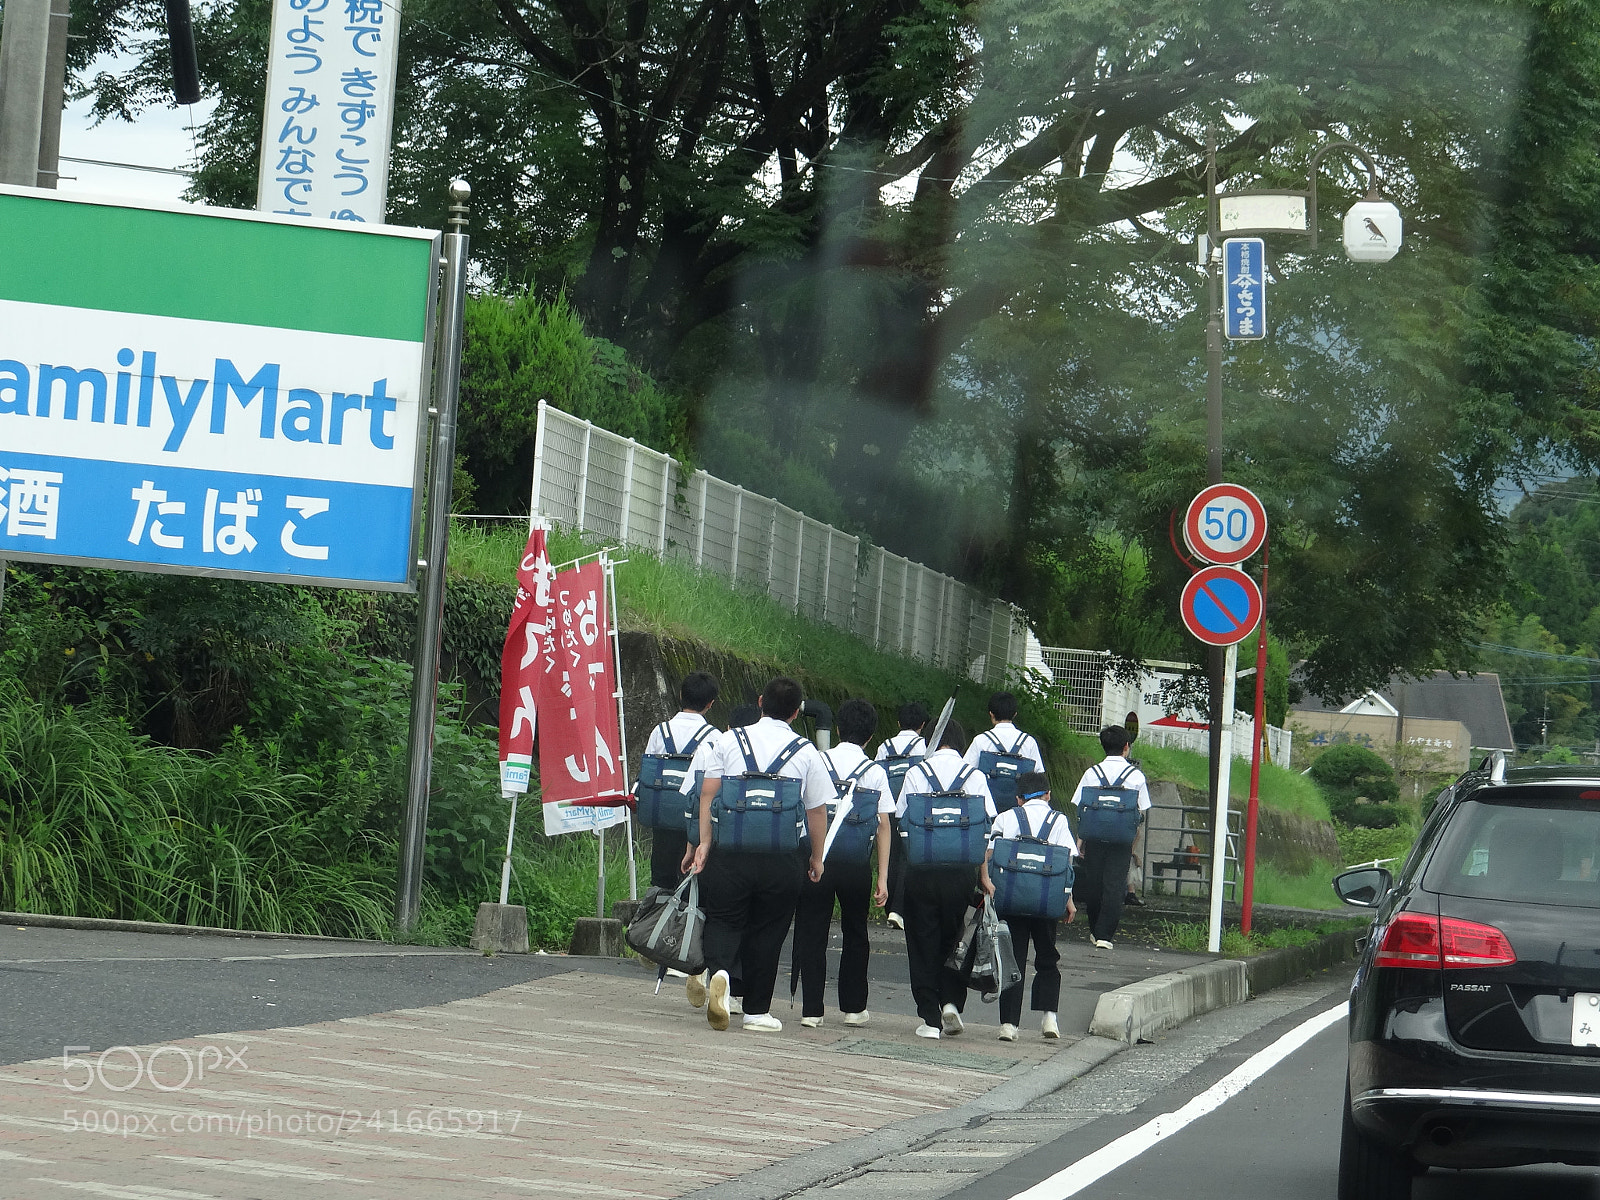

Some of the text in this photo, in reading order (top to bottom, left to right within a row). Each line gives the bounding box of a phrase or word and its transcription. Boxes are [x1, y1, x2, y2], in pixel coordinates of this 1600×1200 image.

[127, 480, 330, 560] たばこ
[1204, 506, 1247, 542] 50
[1450, 984, 1491, 992] PASSAT
[1579, 1022, 1592, 1035] み
